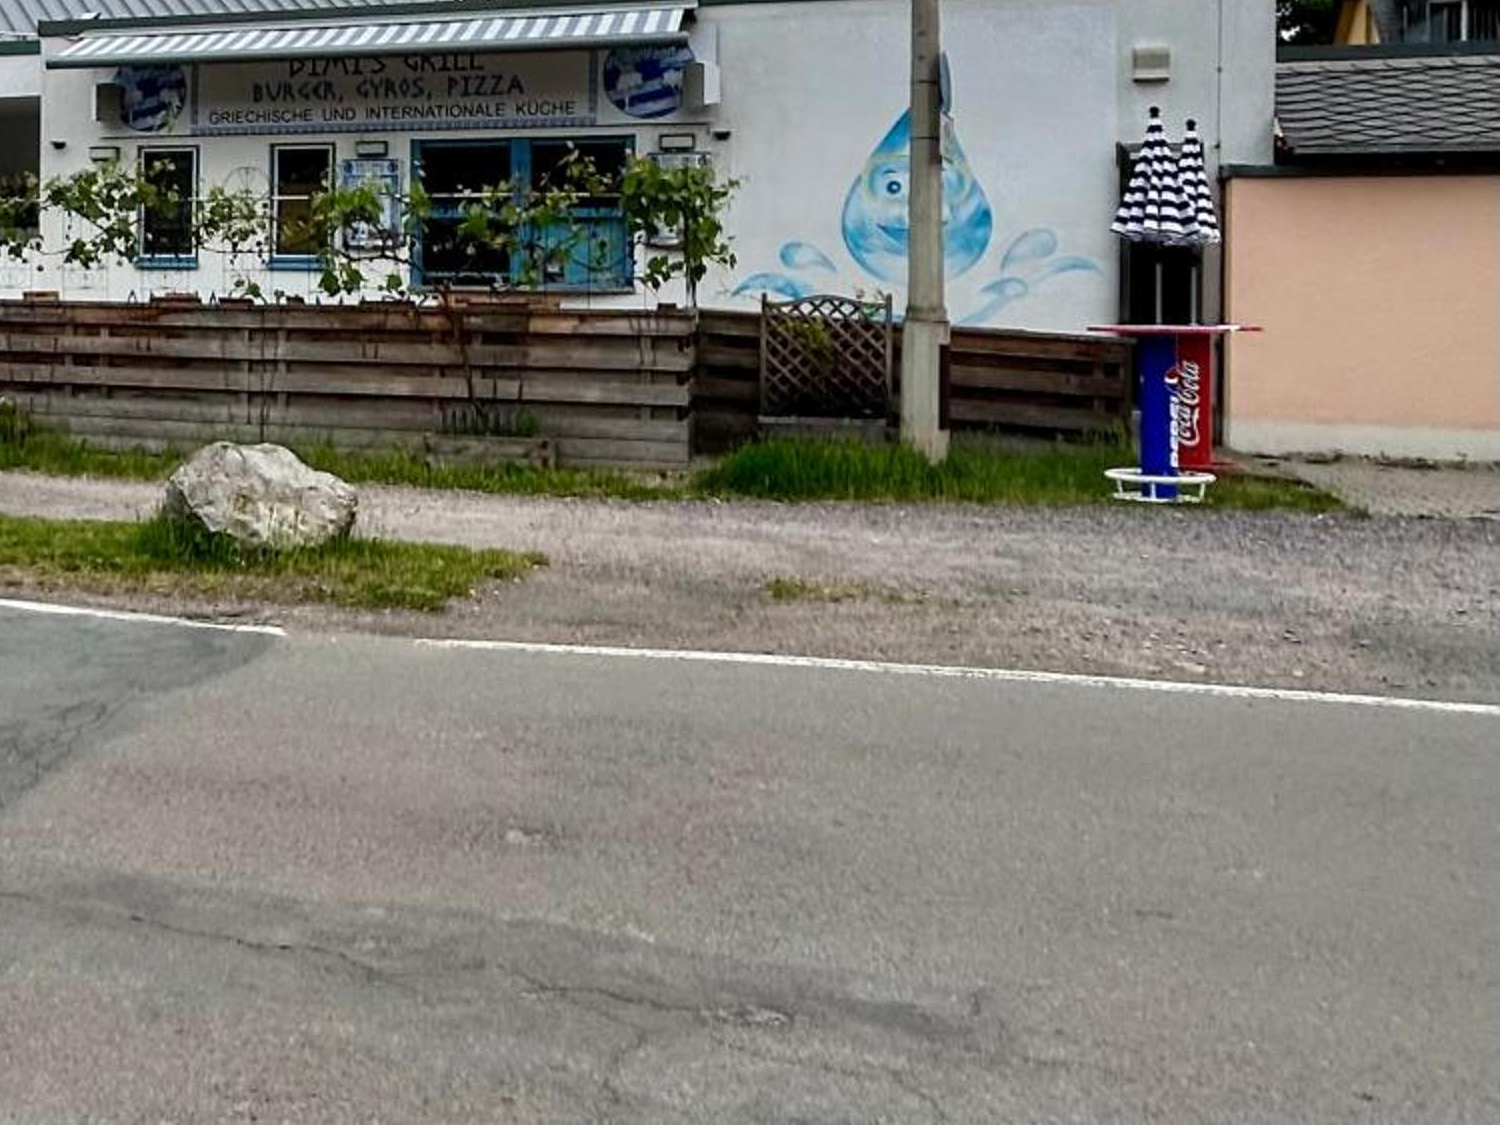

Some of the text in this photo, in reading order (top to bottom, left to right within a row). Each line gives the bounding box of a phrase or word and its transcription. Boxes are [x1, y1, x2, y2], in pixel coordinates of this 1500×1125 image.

[404, 53, 485, 73] GRILL
[253, 74, 525, 103] BURGER, GYROS, PIZZA
[209, 99, 575, 125] GRIECHISCHE UND INTERNATIONALE KÜCHE
